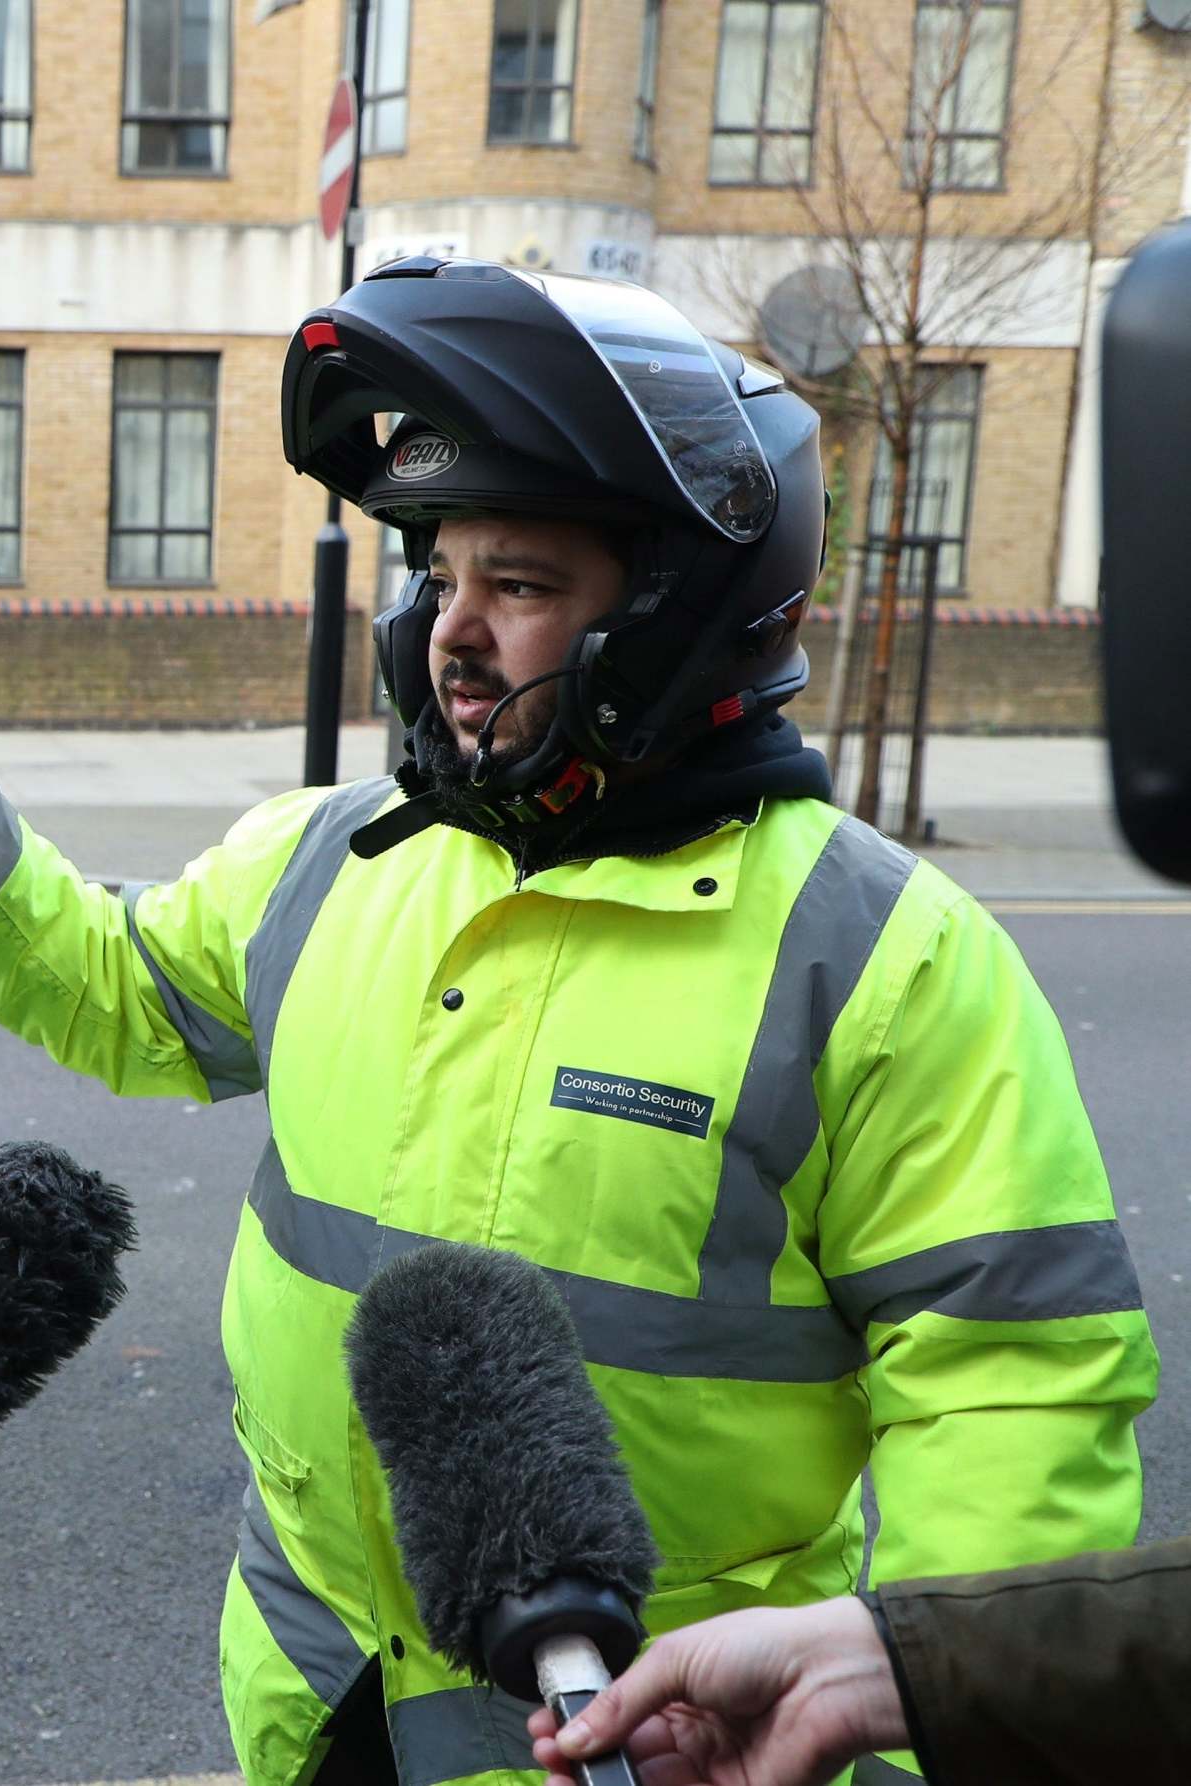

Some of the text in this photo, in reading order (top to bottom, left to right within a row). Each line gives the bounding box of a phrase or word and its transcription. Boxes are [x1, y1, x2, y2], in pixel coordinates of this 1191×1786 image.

[396, 441, 450, 468] VCAN
[560, 1073, 707, 1118] Consortio Security
[585, 1095, 673, 1123] Working in partnership
